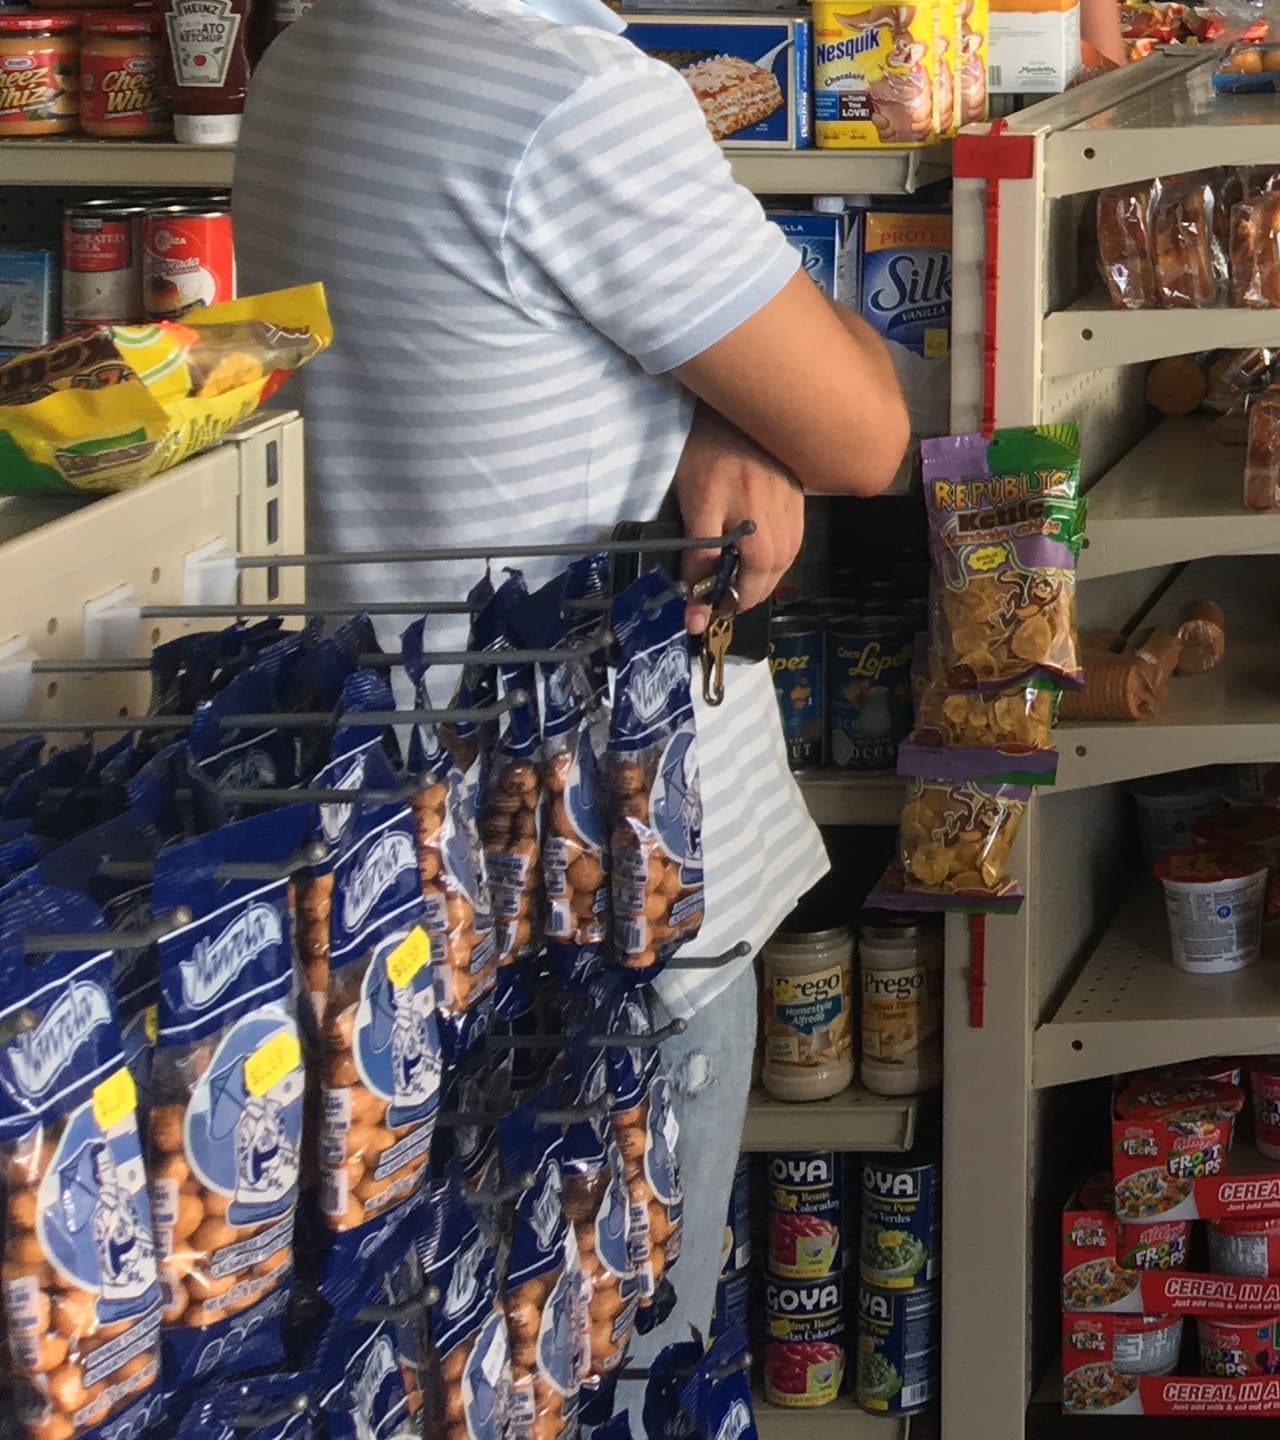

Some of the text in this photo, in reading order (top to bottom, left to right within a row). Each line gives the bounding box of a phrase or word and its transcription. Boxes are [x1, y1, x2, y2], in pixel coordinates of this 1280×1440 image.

[182, 2, 220, 17] HEINZ
[179, 33, 224, 44] KETCHUP
[816, 25, 881, 67] Nesquik
[101, 69, 155, 93] Chee
[824, 71, 866, 87] Chocolate
[107, 88, 152, 112] Whi
[842, 109, 870, 118] LOVE!
[879, 231, 952, 246] PROTEI
[869, 253, 953, 313] Silk
[902, 307, 946, 321] VANILLA
[768, 654, 810, 678] pez
[848, 641, 909, 680] Lope
[864, 972, 925, 1000] Prego
[785, 1001, 833, 1017] Homestyle
[791, 1013, 825, 1027] Alfredo
[1122, 1135, 1157, 1150] FROOT
[1127, 1144, 1159, 1157] LOOPS
[1168, 1144, 1221, 1174] FROOT
[772, 1157, 828, 1183] OYA
[863, 1163, 915, 1196] OYA
[1227, 1202, 1246, 1212] Just
[1246, 1201, 1263, 1211] add
[1263, 1200, 1280, 1210] milk
[1070, 1227, 1105, 1240] FROOT
[1076, 1234, 1107, 1248] LOOPS
[1134, 1236, 1187, 1265] FROOT
[766, 1284, 839, 1311] GOYA
[1164, 1277, 1235, 1300] CEREAL
[1238, 1283, 1260, 1303] IN
[1260, 1283, 1280, 1303] A
[860, 1289, 889, 1318] YA
[1172, 1299, 1189, 1309] Just
[1190, 1300, 1207, 1310] add
[1207, 1300, 1226, 1310] milk
[1234, 1302, 1248, 1310] eat
[1249, 1302, 1262, 1311] out
[1070, 1330, 1105, 1343] FROOT
[1076, 1337, 1106, 1351] LOOPS
[1162, 1382, 1235, 1403] CEREAL
[1238, 1381, 1260, 1401] IN
[1260, 1381, 1280, 1401] A
